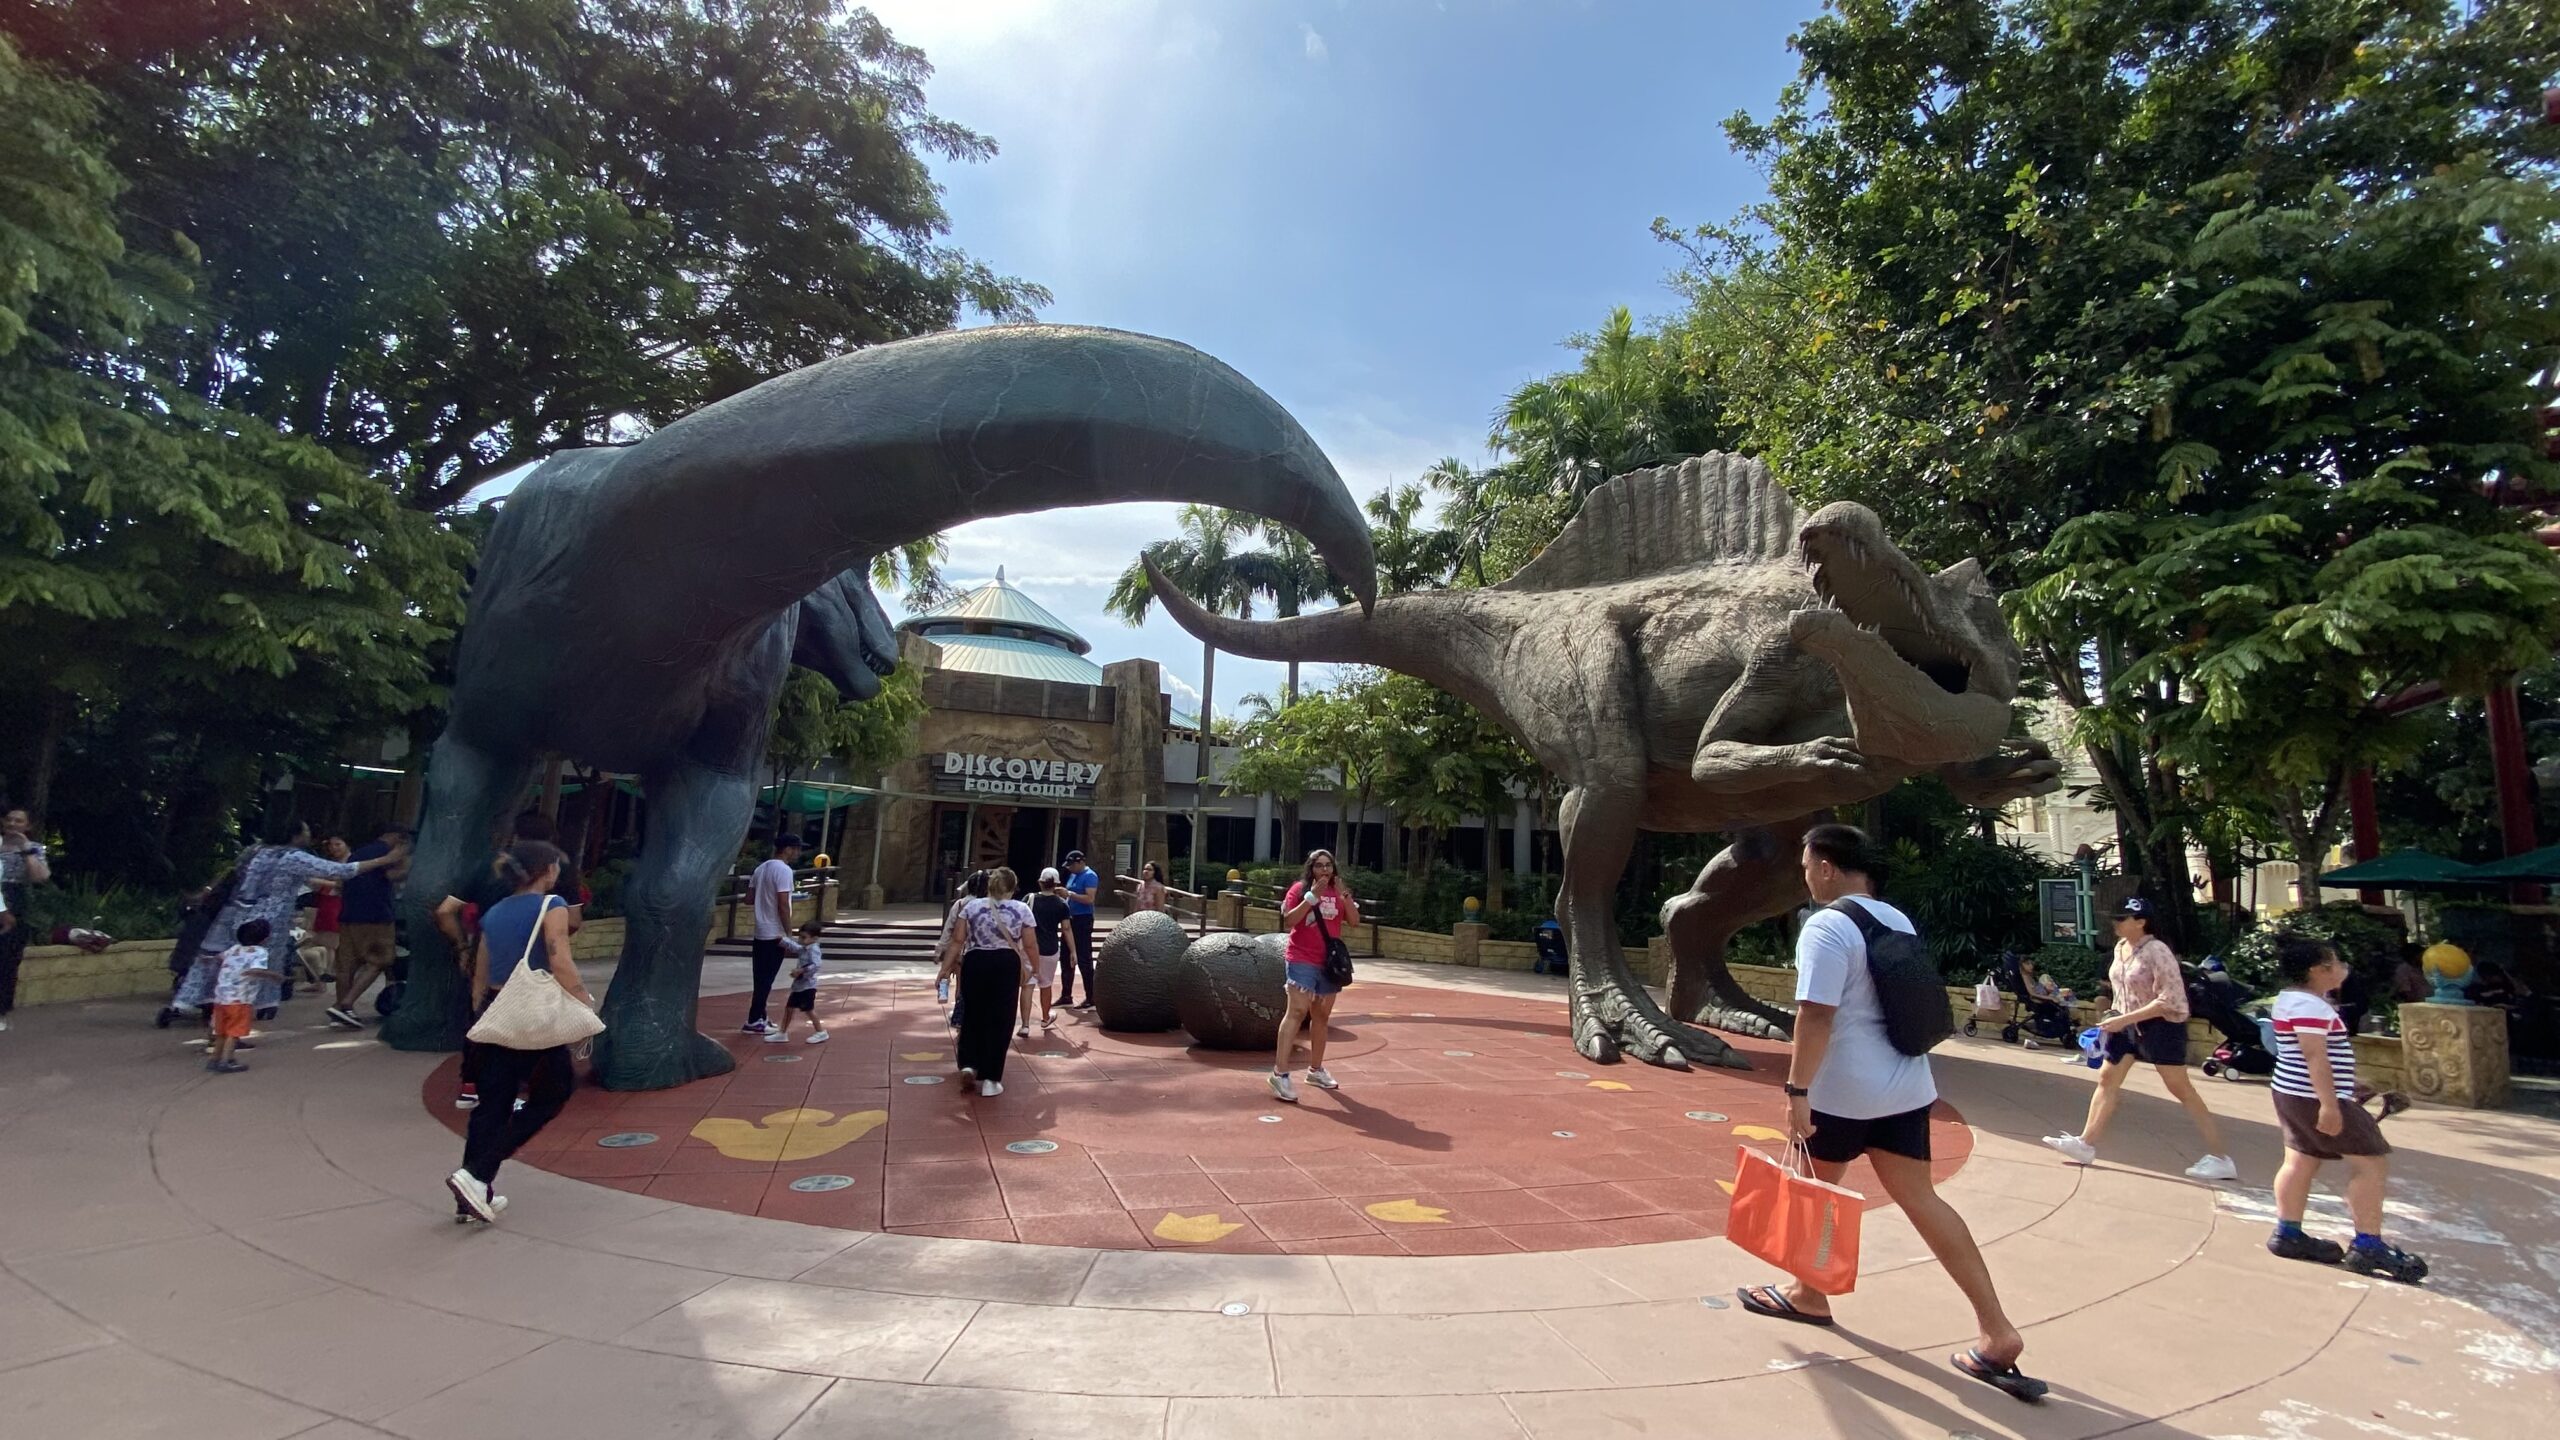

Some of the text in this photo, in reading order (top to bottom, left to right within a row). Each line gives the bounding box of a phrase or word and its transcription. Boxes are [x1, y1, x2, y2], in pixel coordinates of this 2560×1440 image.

[944, 752, 1103, 784] DISCOVERY
[964, 778, 1077, 798] FOOD COURT
